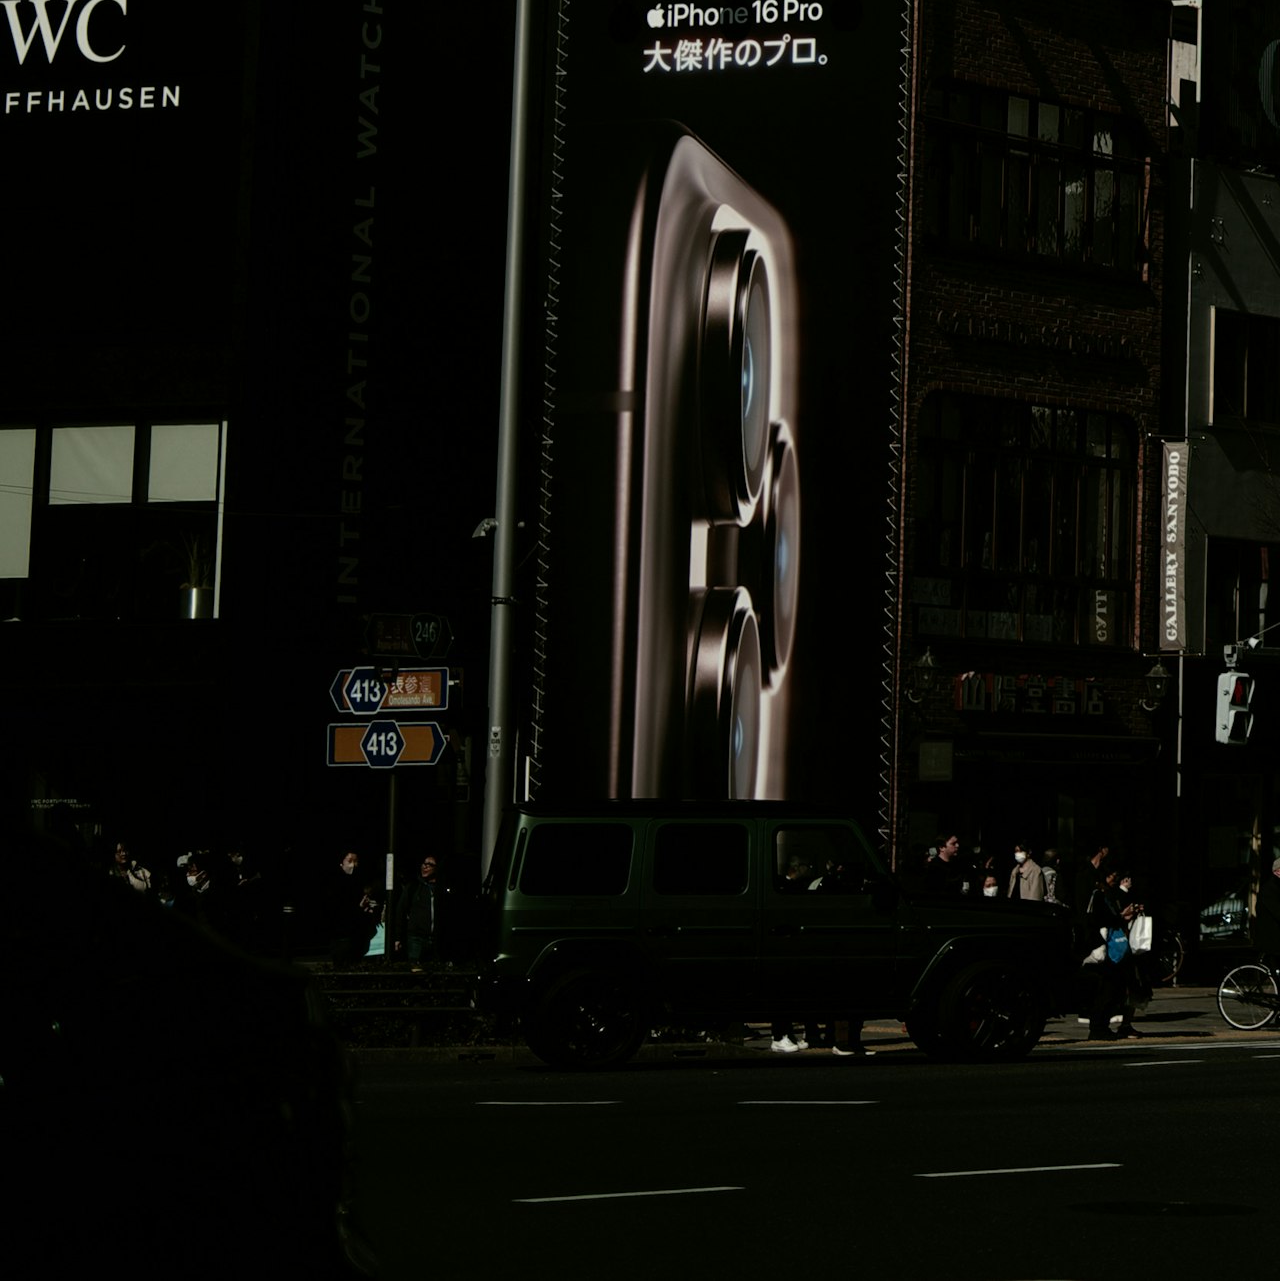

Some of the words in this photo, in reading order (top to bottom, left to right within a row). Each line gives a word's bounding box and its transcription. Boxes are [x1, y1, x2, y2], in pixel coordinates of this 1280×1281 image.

[666, 3, 749, 28] iPhone
[752, 0, 779, 24] 16
[643, 33, 830, 73] 大傑作のプロ。
[1165, 551, 1179, 642] GALLERY
[415, 621, 438, 643] 246
[350, 678, 382, 703] 413
[390, 676, 433, 694] 表参道
[366, 731, 398, 757] 413
